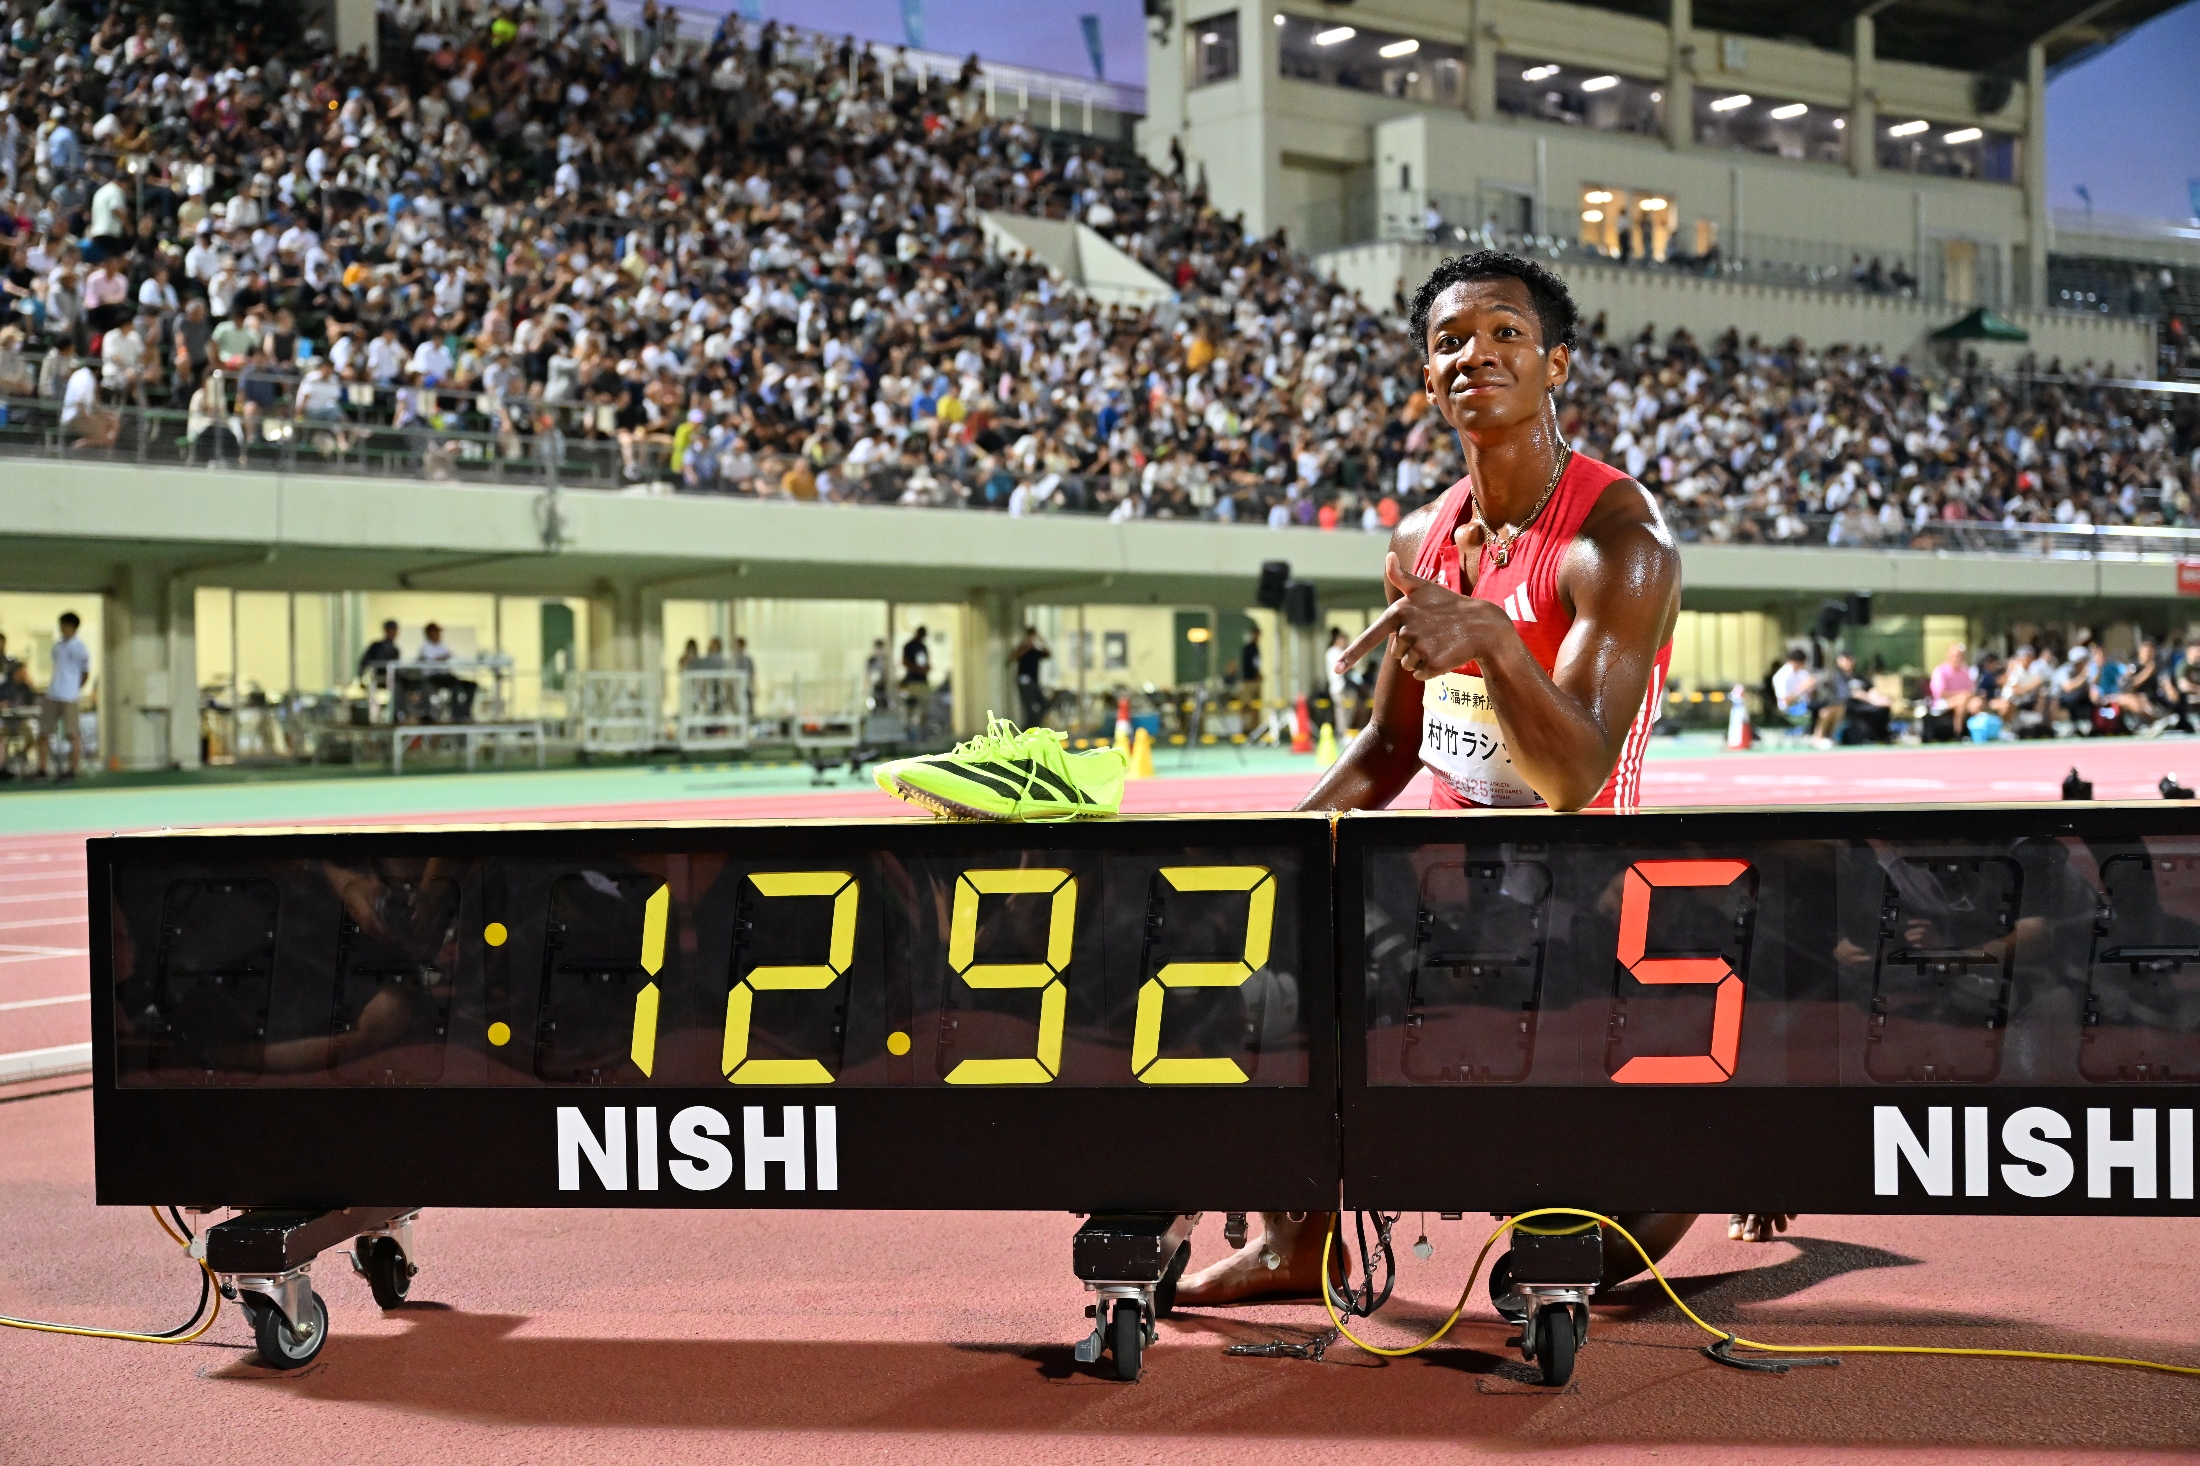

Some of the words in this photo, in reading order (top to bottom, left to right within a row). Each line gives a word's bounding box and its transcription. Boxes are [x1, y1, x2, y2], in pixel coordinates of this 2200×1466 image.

[1453, 774, 1489, 798] 2025
[1611, 859, 1750, 1083] 5
[556, 1105, 838, 1191] NISHI
[1873, 1106, 2194, 1199] NISHI
